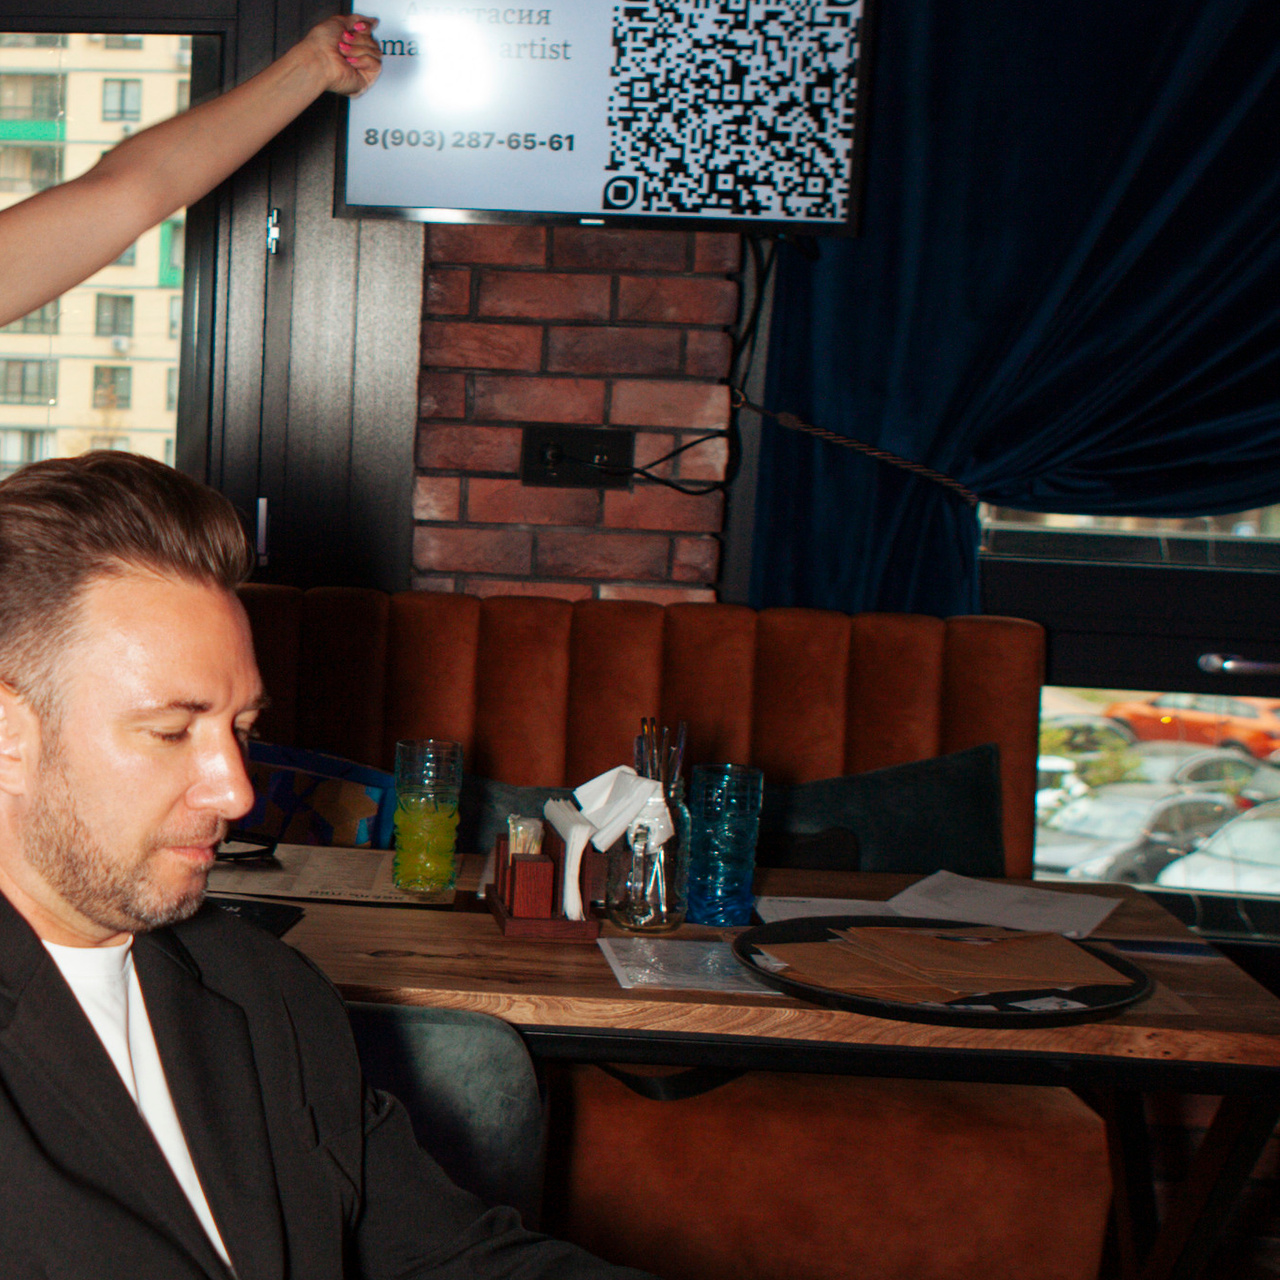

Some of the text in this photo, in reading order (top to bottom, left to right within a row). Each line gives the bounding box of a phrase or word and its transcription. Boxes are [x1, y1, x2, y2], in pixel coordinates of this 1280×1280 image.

[499, 36, 573, 60] artist
[364, 128, 575, 152] 8(903) 287-65-61
